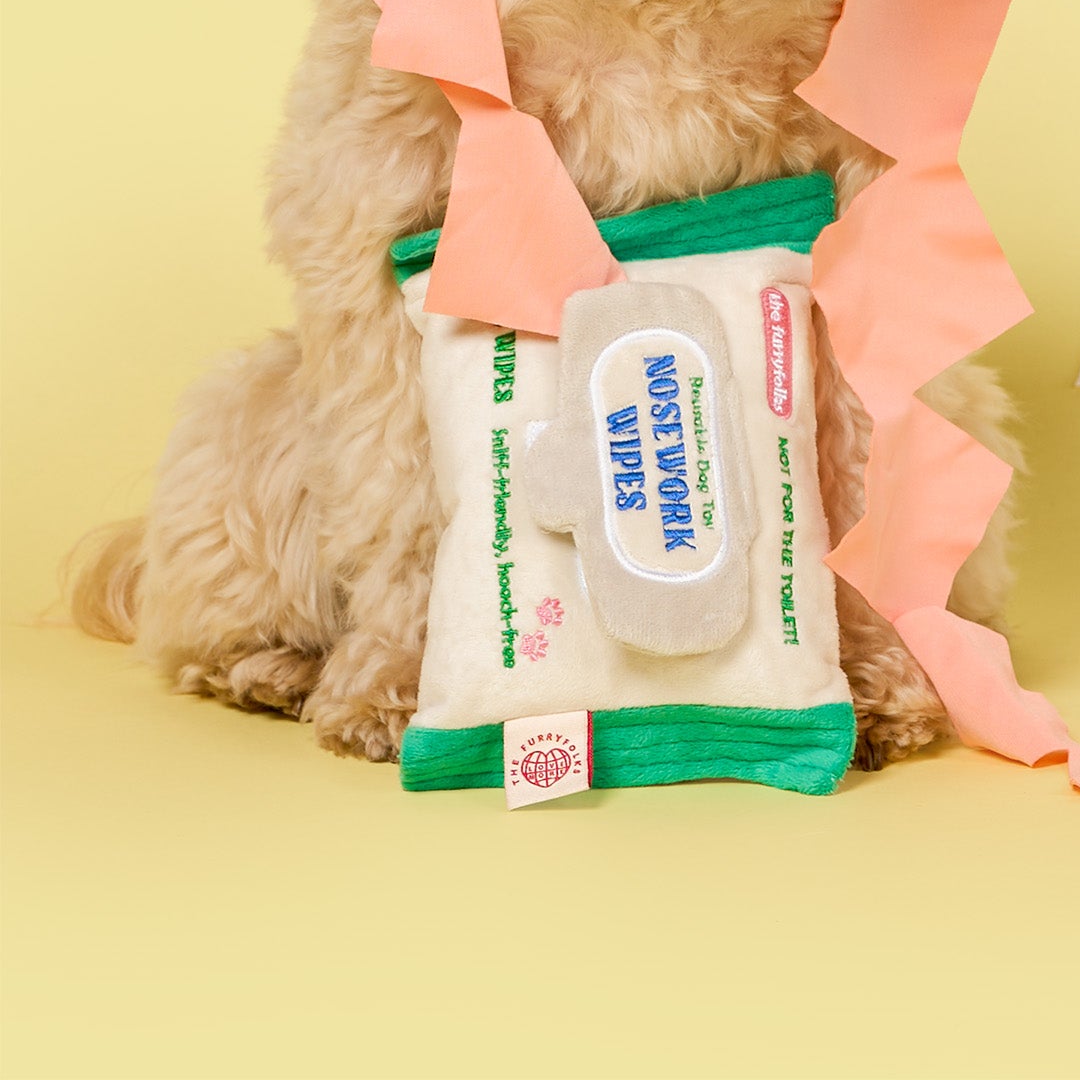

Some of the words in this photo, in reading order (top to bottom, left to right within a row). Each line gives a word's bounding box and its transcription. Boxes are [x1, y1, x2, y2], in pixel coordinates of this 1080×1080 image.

[767, 294, 783, 325] the
[493, 330, 515, 404] WIPES
[769, 330, 788, 417] furryfolks
[606, 405, 647, 511] WIPES
[644, 355, 695, 551] NOSEWORK
[779, 437, 790, 473] NOT
[782, 483, 794, 523] FOR
[781, 531, 793, 566] THE
[781, 575, 800, 645] TOILET!
[510, 759, 519, 785] THE
[520, 732, 581, 774] FURRYFOLKS
[528, 761, 564, 771] LOVE
